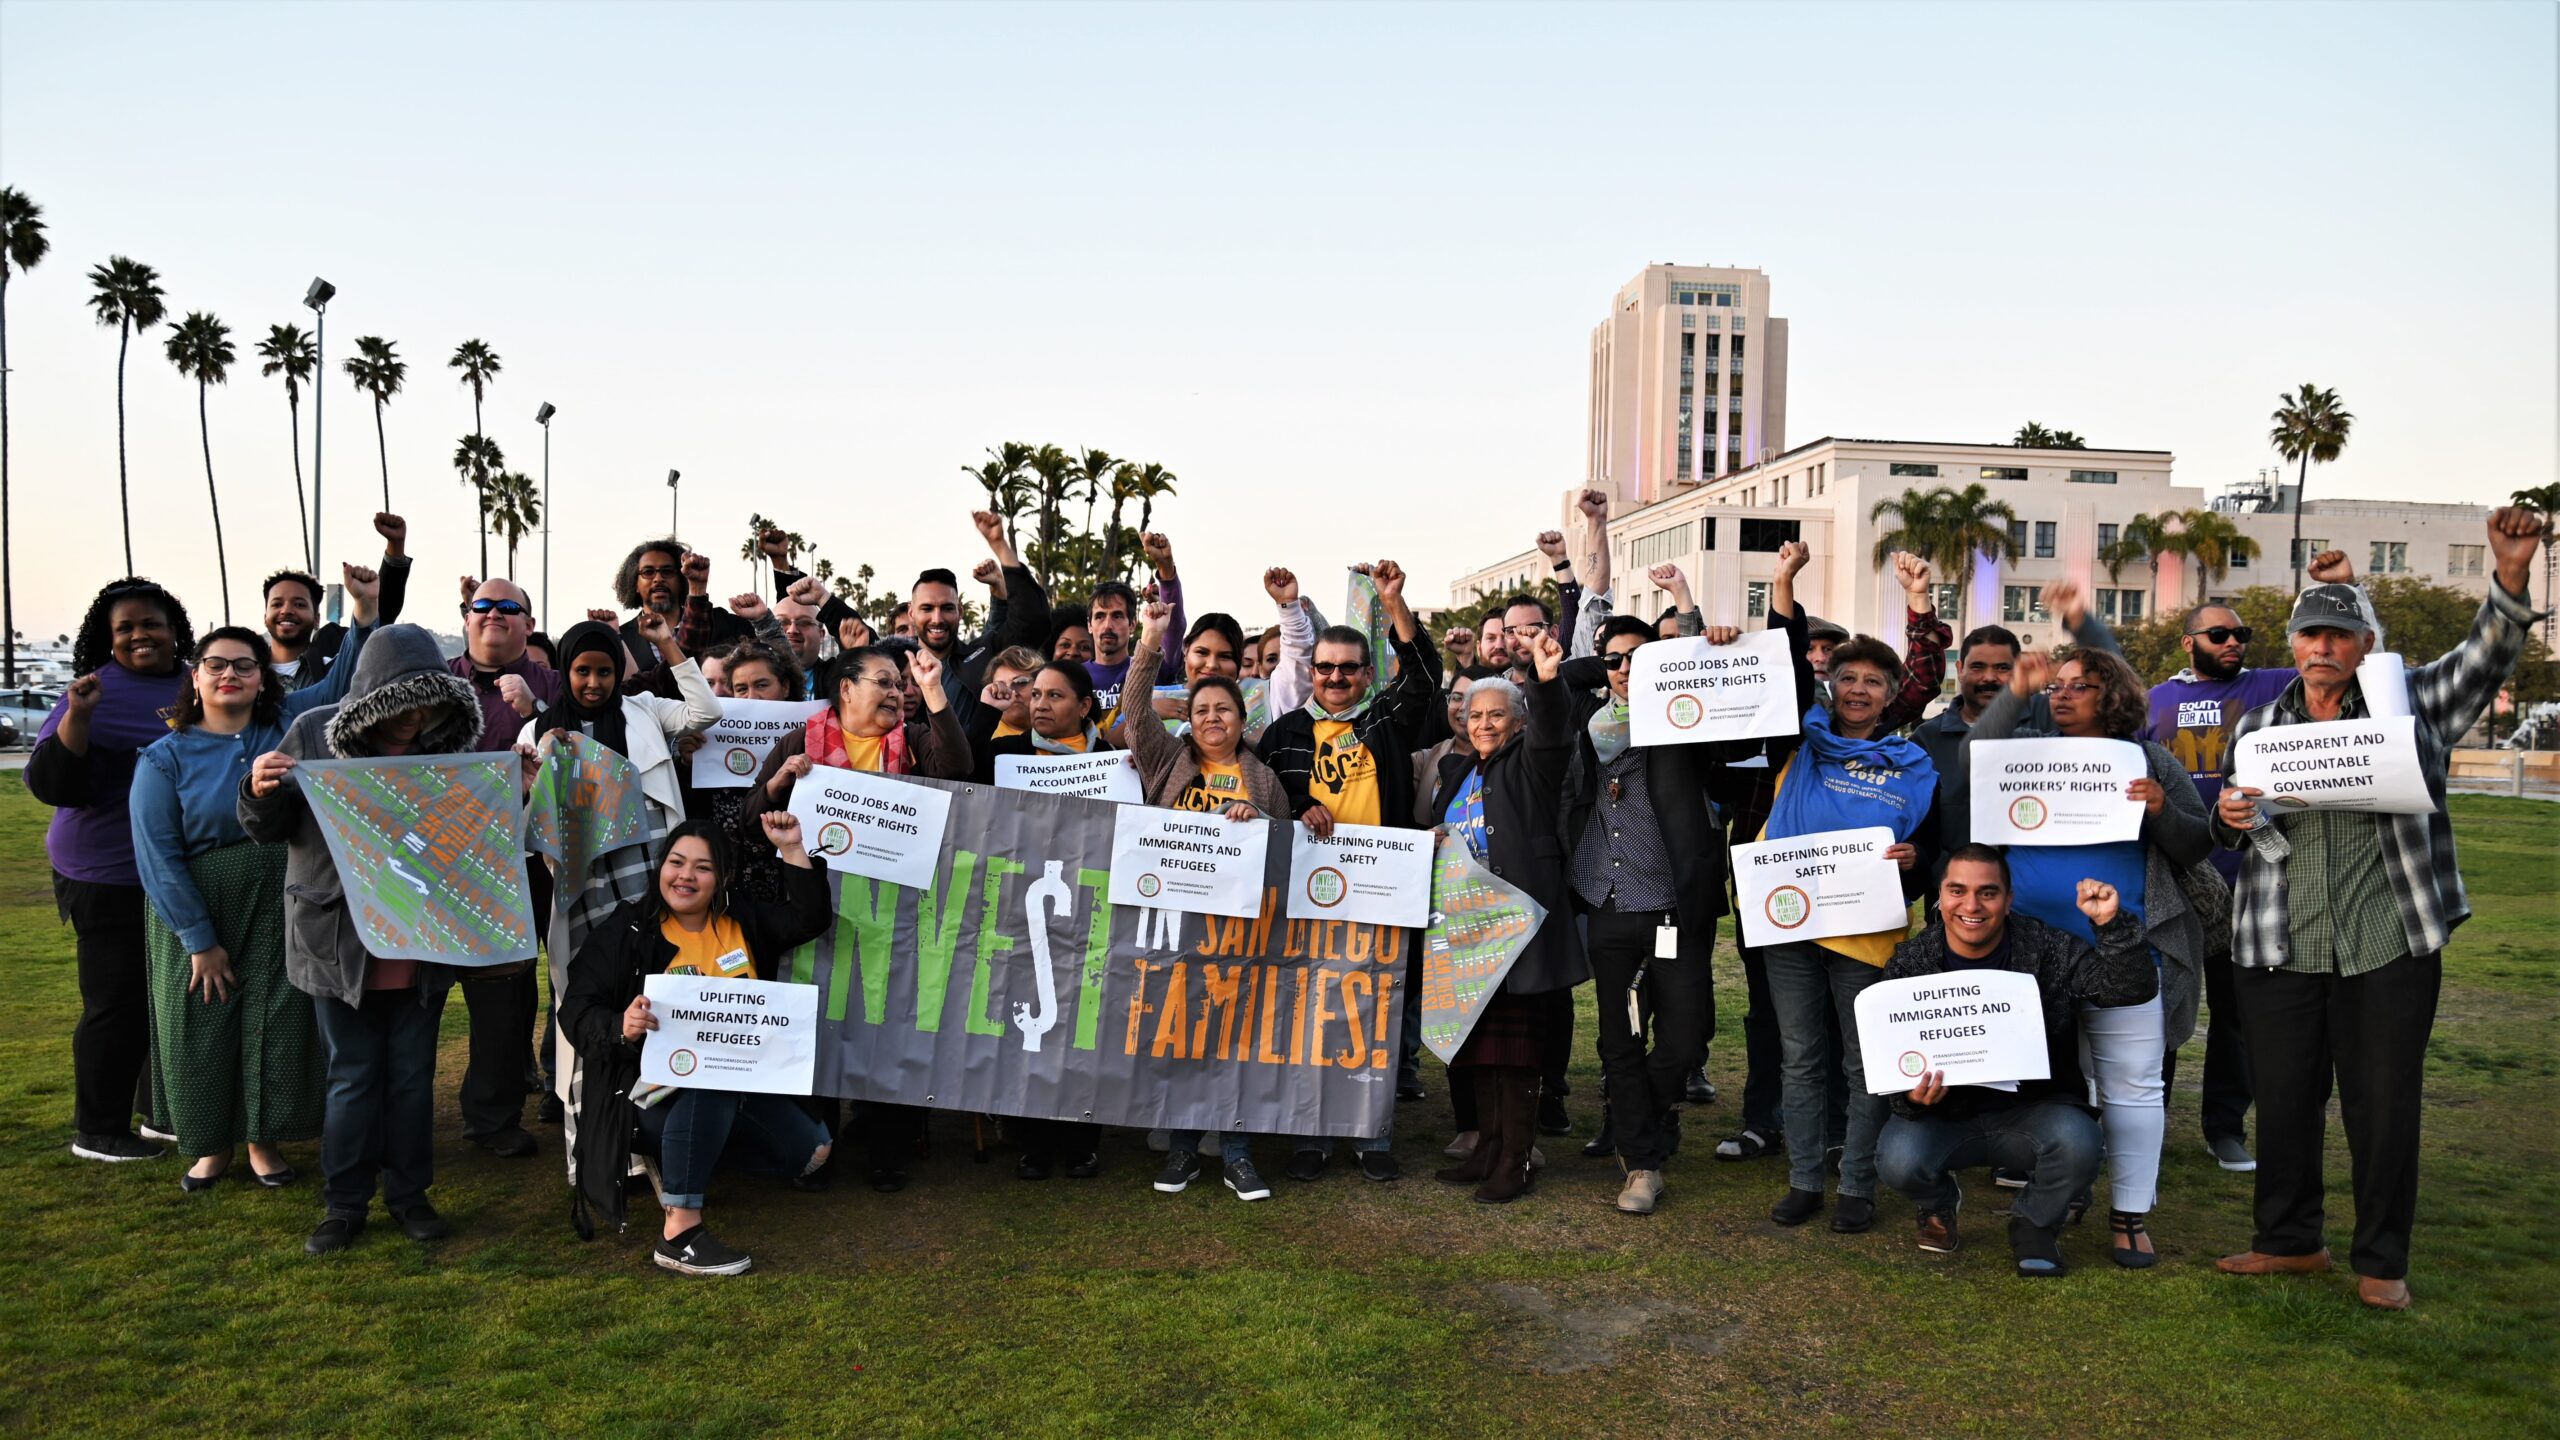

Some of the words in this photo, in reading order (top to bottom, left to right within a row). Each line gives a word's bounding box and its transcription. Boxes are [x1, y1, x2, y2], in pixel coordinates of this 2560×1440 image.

[1659, 661, 1695, 673] GOOD
[1699, 659, 1729, 670] JOBS
[1732, 656, 1759, 668] AND
[1655, 677, 1718, 691] WORKERS'
[1722, 673, 1766, 687] RIGHTS
[2179, 700, 2221, 712] EQUITY
[720, 719, 751, 729] GOOD
[754, 721, 780, 730] JOBS
[2179, 714, 2195, 723] FOR
[2199, 712, 2219, 724] ALL
[715, 734, 770, 745] WORKERS'
[2254, 736, 2349, 754] TRANSPARENT
[2353, 733, 2385, 746] AND
[1016, 761, 1092, 774] TRANSPARENT
[1095, 757, 1119, 767] AND
[2005, 763, 2044, 773] GOOD
[2048, 763, 2078, 773] JOBS
[2082, 763, 2111, 773] AND
[2270, 755, 2371, 773] ACCOUNTABLE
[1029, 773, 1108, 787] ACCOUNTABLE
[1848, 770, 1886, 785] 2020
[2273, 775, 2374, 792] GOVERNMENT
[1824, 781, 1846, 793] CENSUS
[1847, 788, 1877, 799] OUTREACH
[2000, 781, 2066, 792] WORKERS'
[2070, 782, 2117, 792] RIGHTS
[824, 788, 859, 803] GOOD
[862, 797, 889, 811] JOBS
[892, 803, 917, 817] AND
[816, 804, 876, 824] WORKERS'
[877, 818, 918, 835] RIGHTS
[1163, 822, 1220, 837] UPLIFTING
[403, 832, 426, 853] IN
[1139, 837, 1214, 854] IMMIGRANTS
[1216, 846, 1241, 857] AND
[1307, 835, 1373, 848] RE-DEFINING
[1376, 840, 1414, 852] PUBLIC
[1339, 853, 1378, 865] SAFETY
[1754, 846, 1829, 865] RE-DEFINING
[1832, 842, 1874, 855] PUBLIC
[1160, 857, 1216, 873] REFUGEES
[1795, 864, 1836, 878] SAFETY
[1135, 907, 1182, 951] IN
[1196, 887, 1278, 957] SAN
[1283, 918, 1400, 964] DIEGO
[1432, 939, 1449, 951] IN
[1432, 952, 1450, 976] SAN
[699, 992, 766, 1005] UPLIFTING
[1913, 985, 1981, 1001] UPLIFTING
[671, 1009, 758, 1025] IMMIGRANTS
[761, 1015, 789, 1027] AND
[1125, 959, 1393, 1069] FAMILIES!
[1889, 1004, 1978, 1023] IMMIGRANTS
[1981, 1002, 2011, 1015] AND
[696, 1031, 761, 1046] REFUGEES
[1919, 1024, 1986, 1041] REFUGEES
